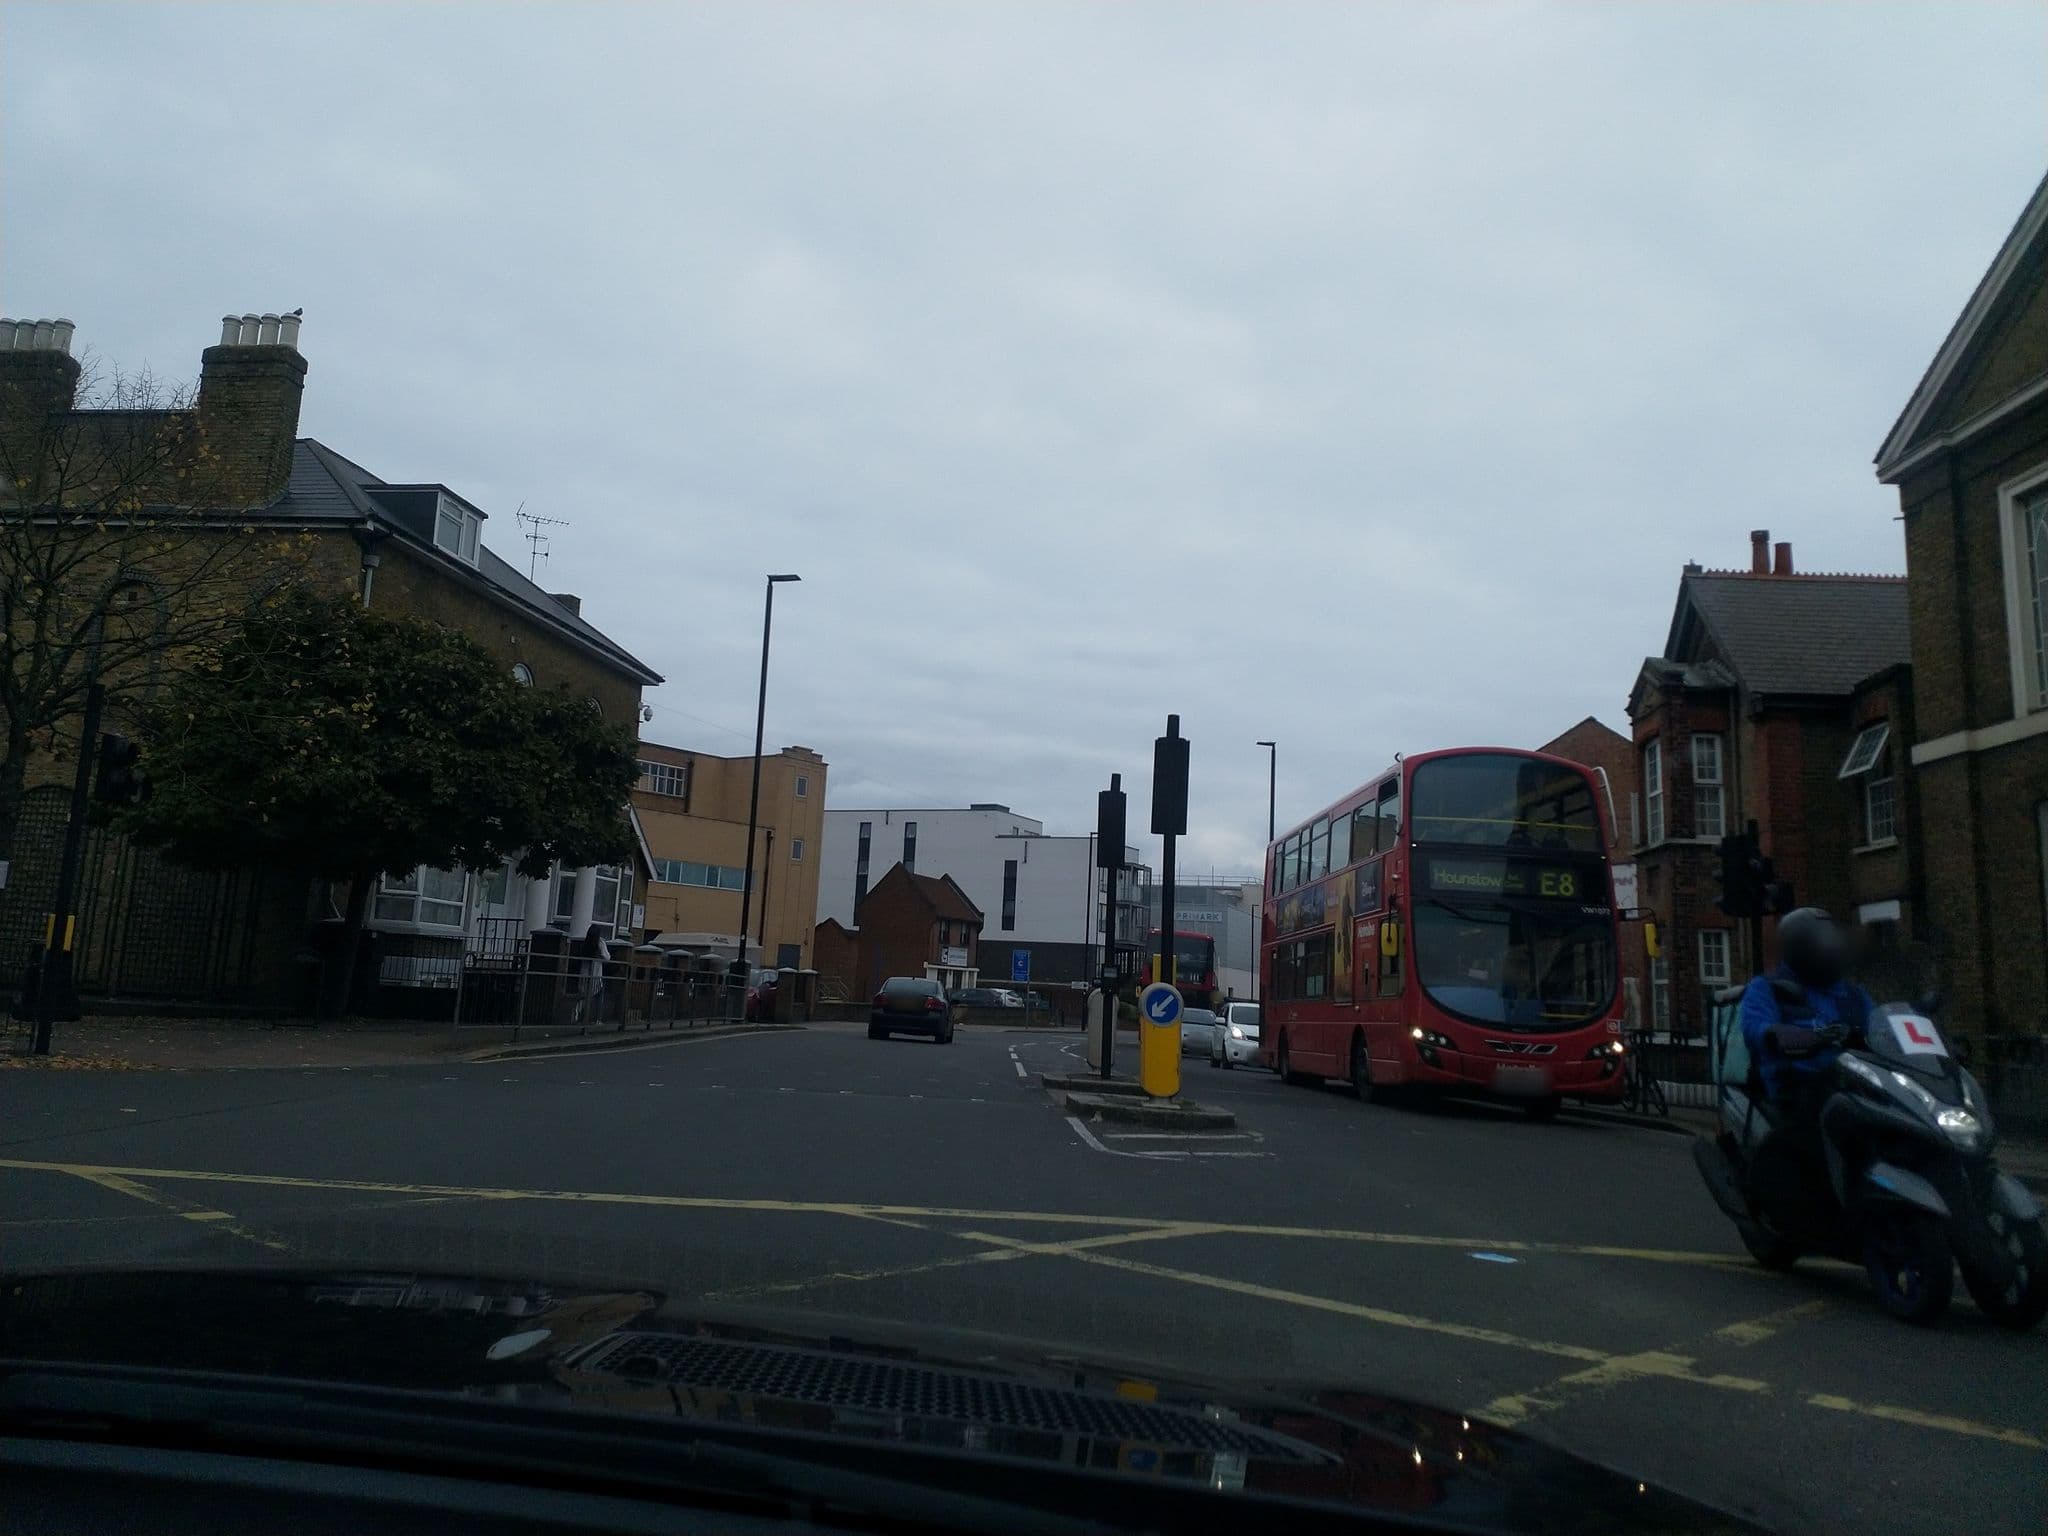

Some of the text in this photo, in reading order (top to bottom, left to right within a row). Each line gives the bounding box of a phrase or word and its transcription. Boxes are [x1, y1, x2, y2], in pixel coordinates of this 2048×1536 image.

[1433, 870, 1502, 887] Hounslow
[1541, 872, 1575, 896] E8
[1175, 912, 1220, 921] PRIMARK
[1904, 1022, 1934, 1044] L
